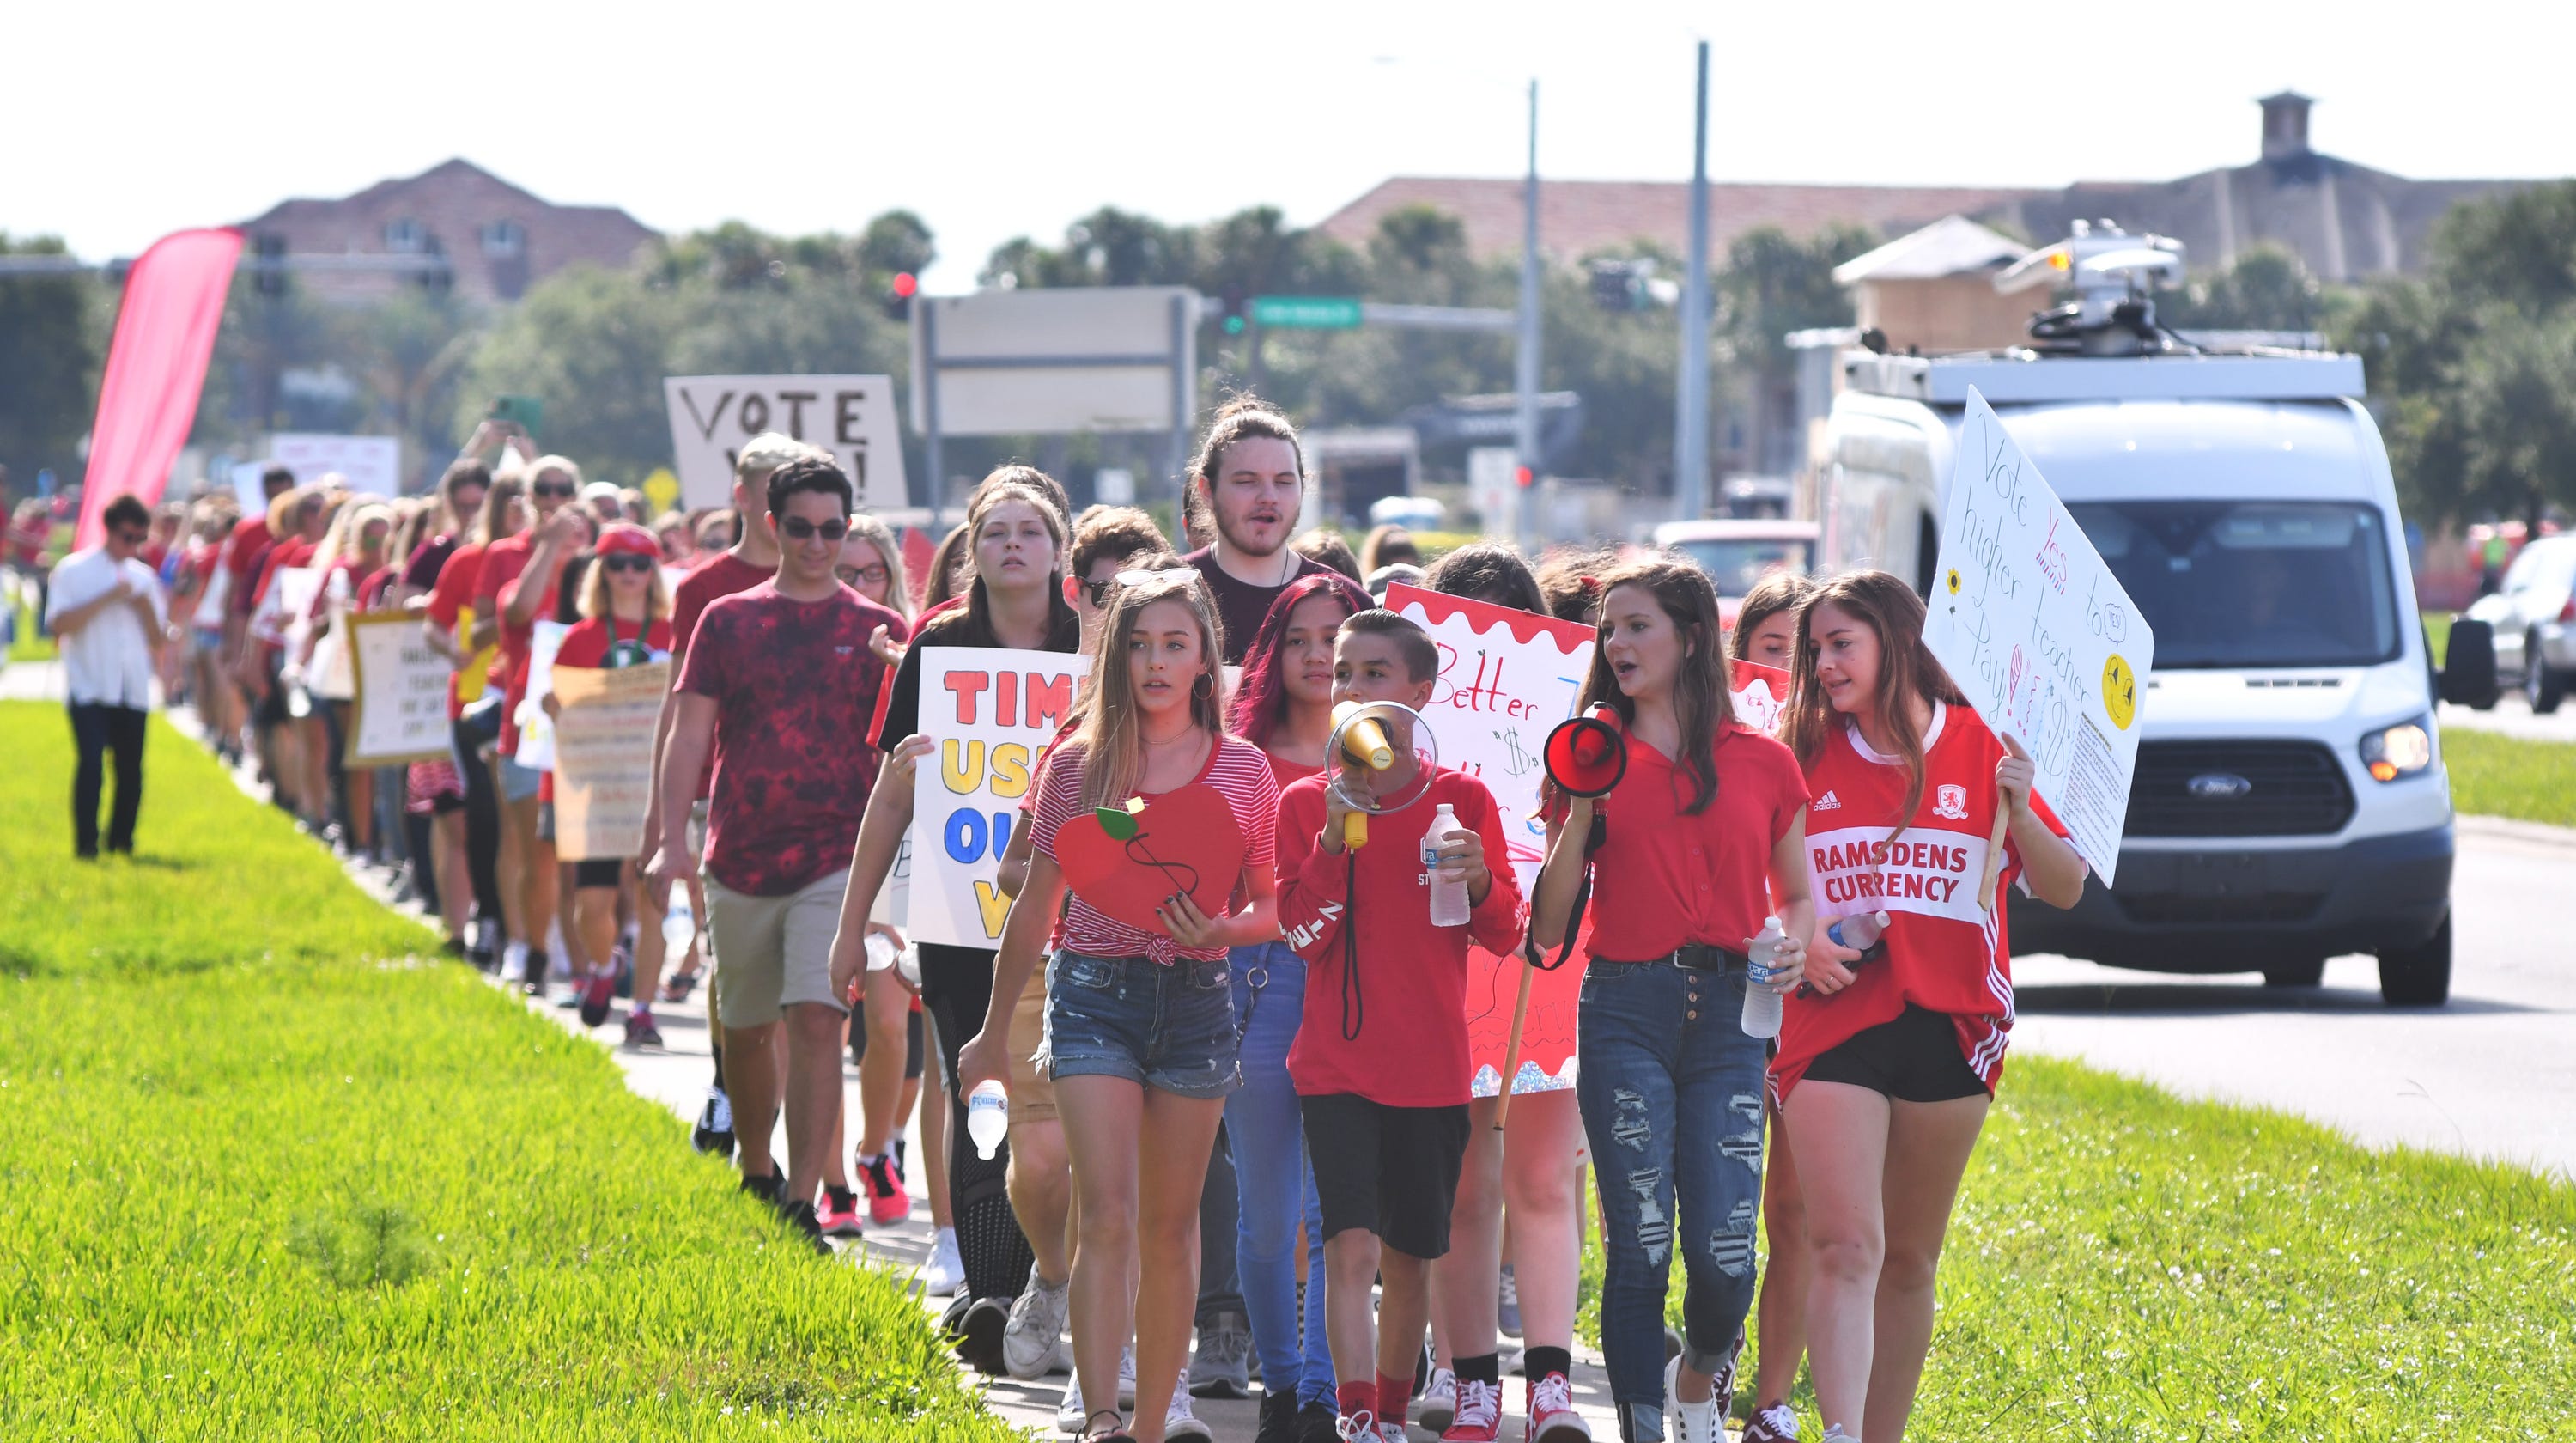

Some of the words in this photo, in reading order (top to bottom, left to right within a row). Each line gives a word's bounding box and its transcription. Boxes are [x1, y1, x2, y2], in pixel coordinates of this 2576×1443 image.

[679, 388, 868, 445] VOTE
[1978, 413, 2027, 527] Vote
[2043, 506, 2067, 582] Yes
[2086, 573, 2103, 636] to
[1961, 481, 2022, 607] higher
[2032, 584, 2092, 703] teacher
[944, 671, 1090, 729] TIM
[1428, 642, 1538, 721] Better
[941, 739, 1047, 799] US
[1814, 801, 1842, 811] adidas
[1813, 840, 1968, 873] RAMSDENS
[1825, 872, 1959, 904] CURRENCY
